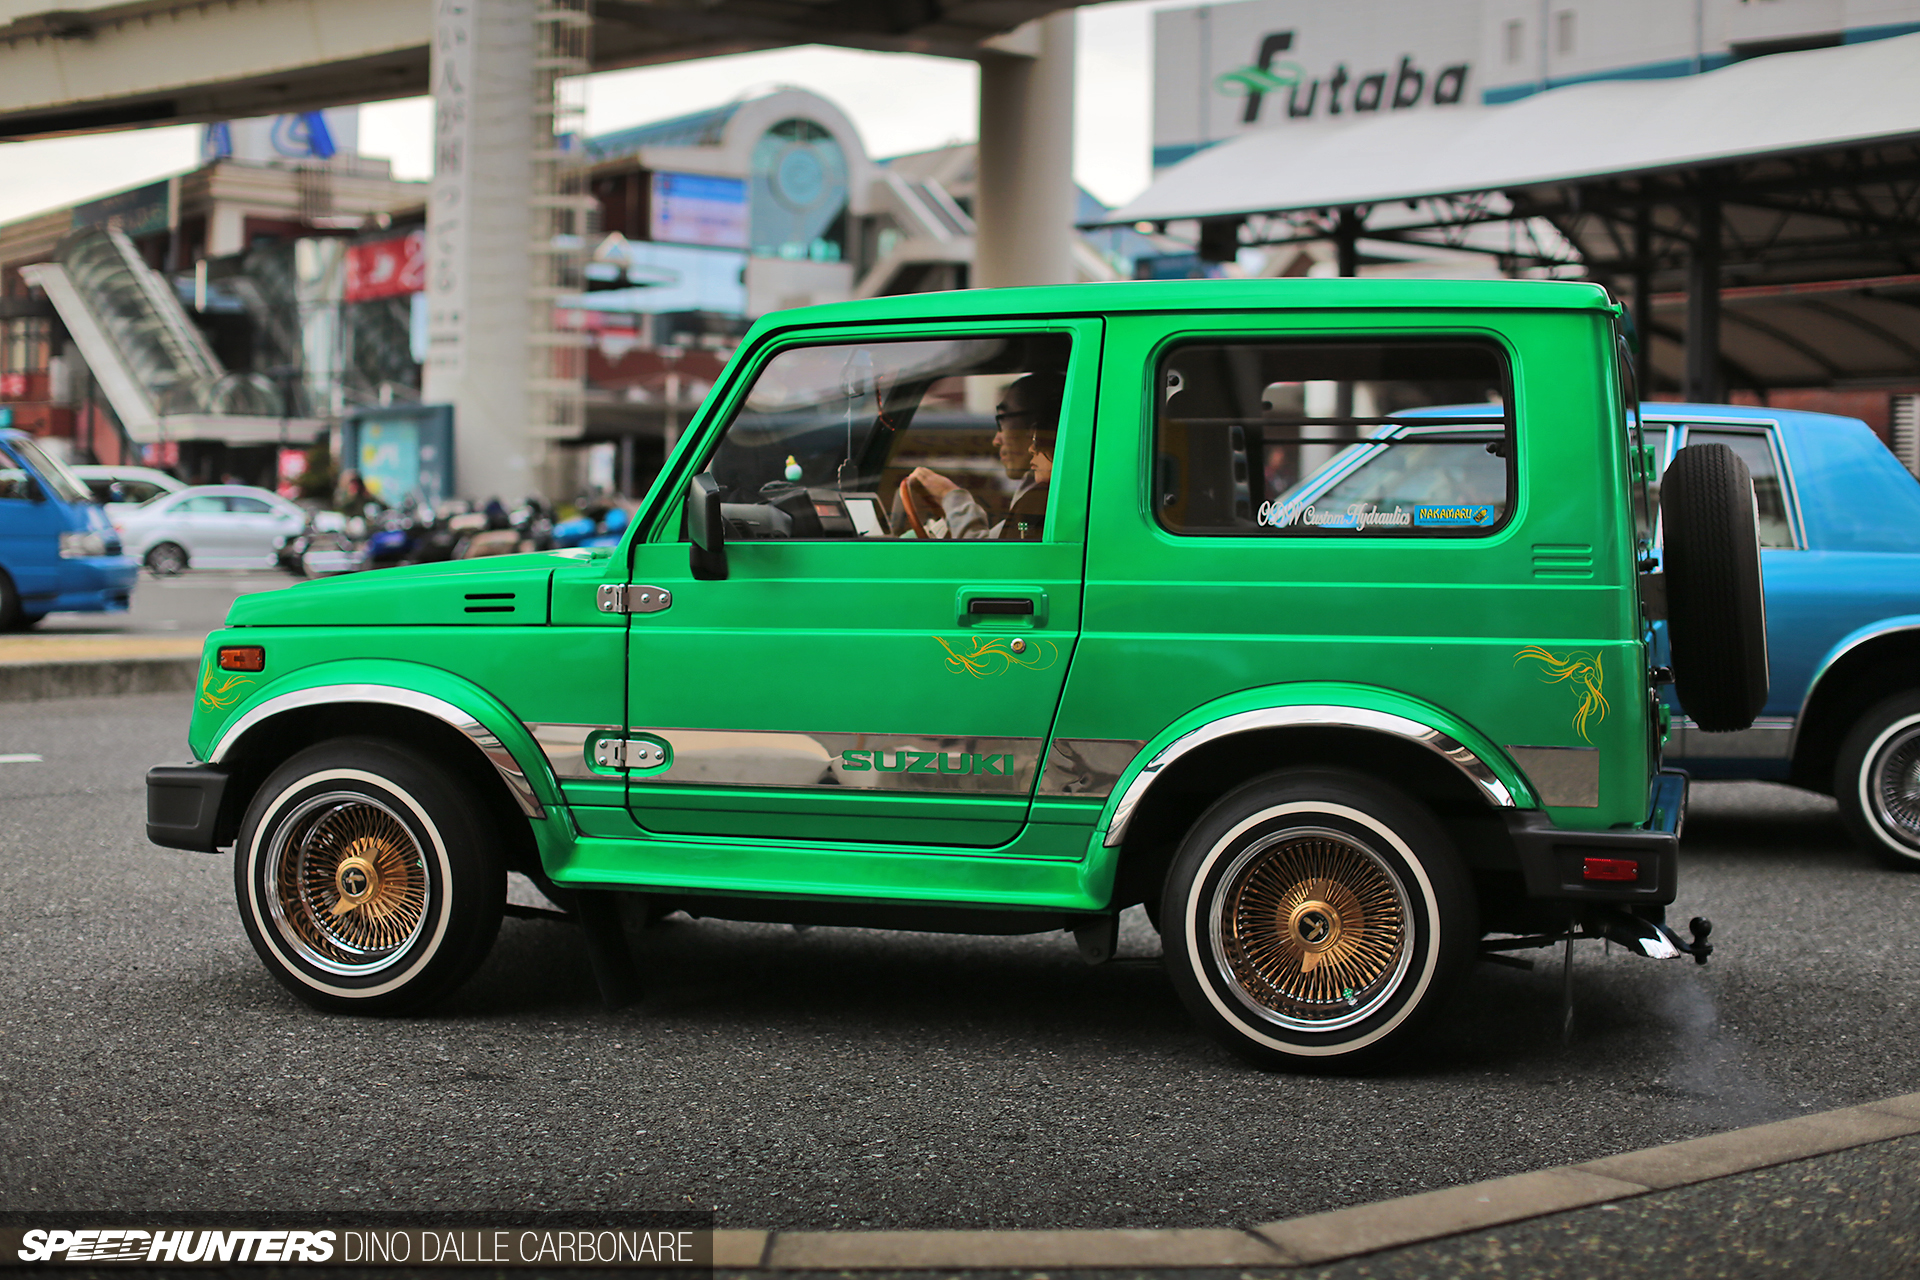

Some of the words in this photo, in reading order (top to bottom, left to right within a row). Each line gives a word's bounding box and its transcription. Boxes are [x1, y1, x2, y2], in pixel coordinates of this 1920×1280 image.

[1218, 31, 1469, 123] Futaba
[1303, 505, 1345, 526] Custom
[1346, 502, 1411, 531] Hydraulics
[1419, 507, 1472, 520] NAKAMARU
[842, 749, 1014, 776] SUZUKI
